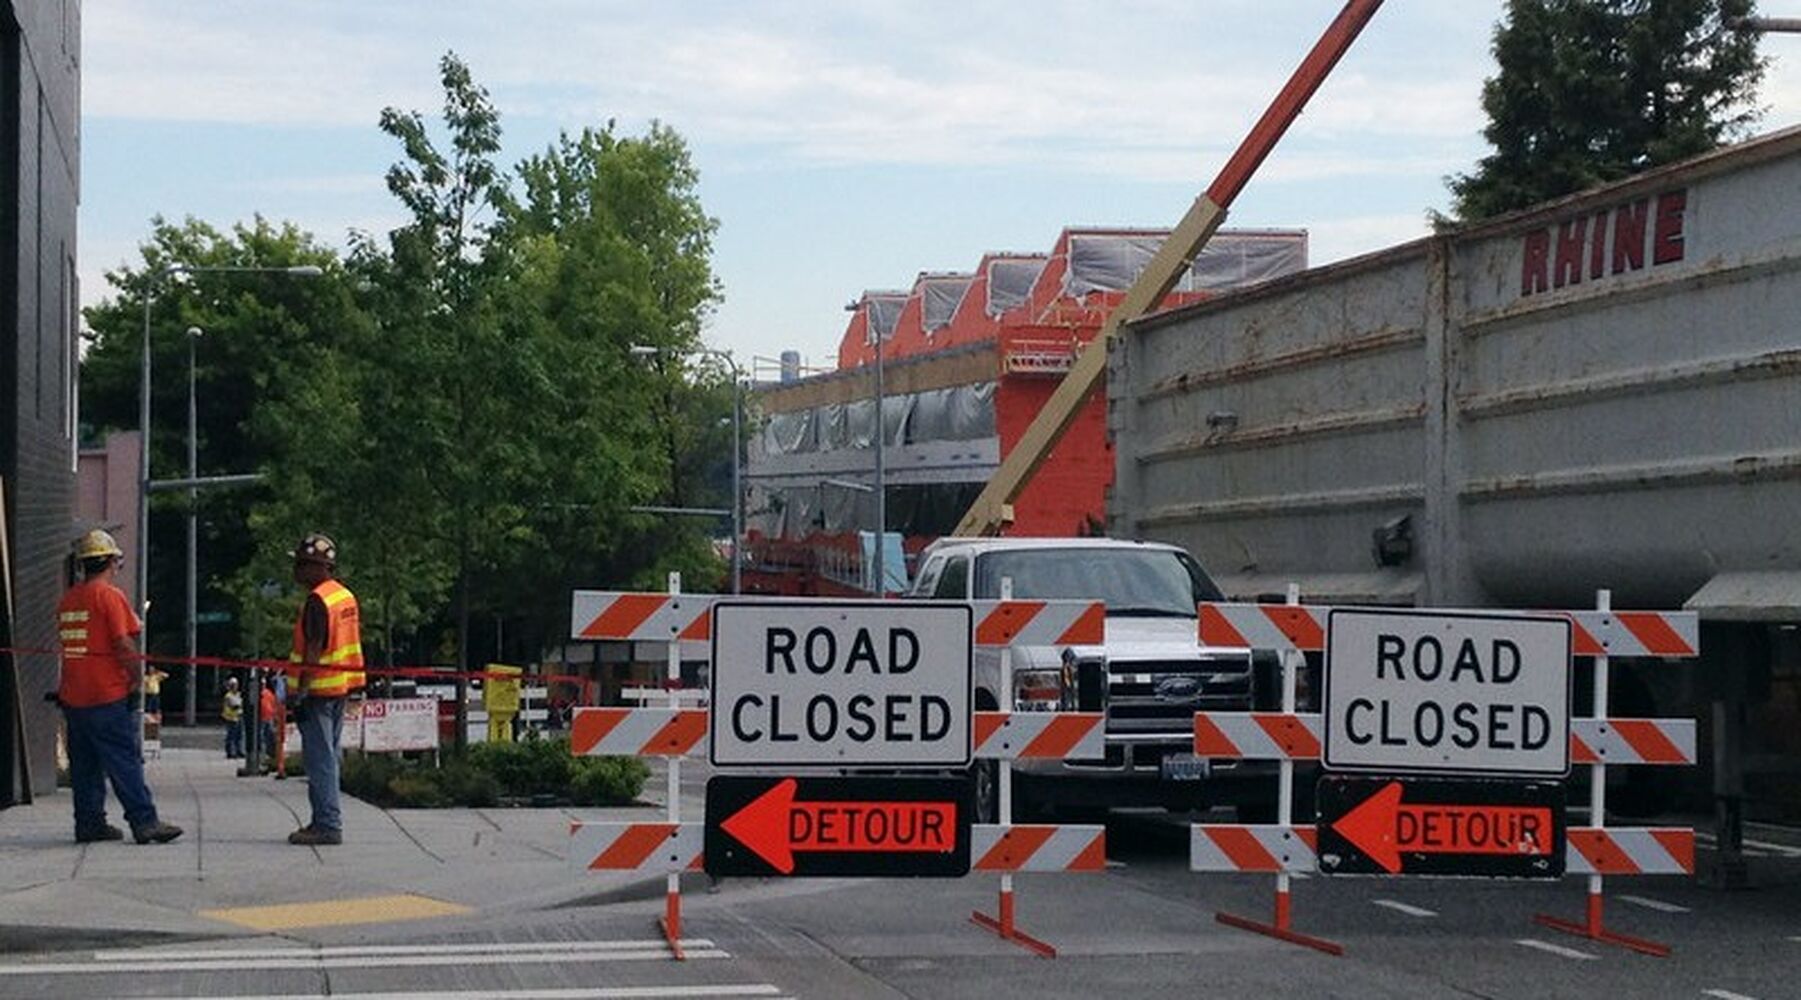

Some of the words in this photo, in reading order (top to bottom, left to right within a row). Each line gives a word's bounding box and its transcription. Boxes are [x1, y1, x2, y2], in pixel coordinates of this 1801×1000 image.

[1521, 189, 1688, 297] RHINE
[765, 626, 920, 674] ROAD
[1376, 634, 1522, 684] ROAD
[365, 702, 384, 717] NO
[388, 700, 434, 713] PARKING
[731, 693, 951, 743] CLOSED
[1345, 698, 1551, 751] CLOSED
[788, 808, 944, 845] DETOUR
[1395, 811, 1541, 849] DETOUR
